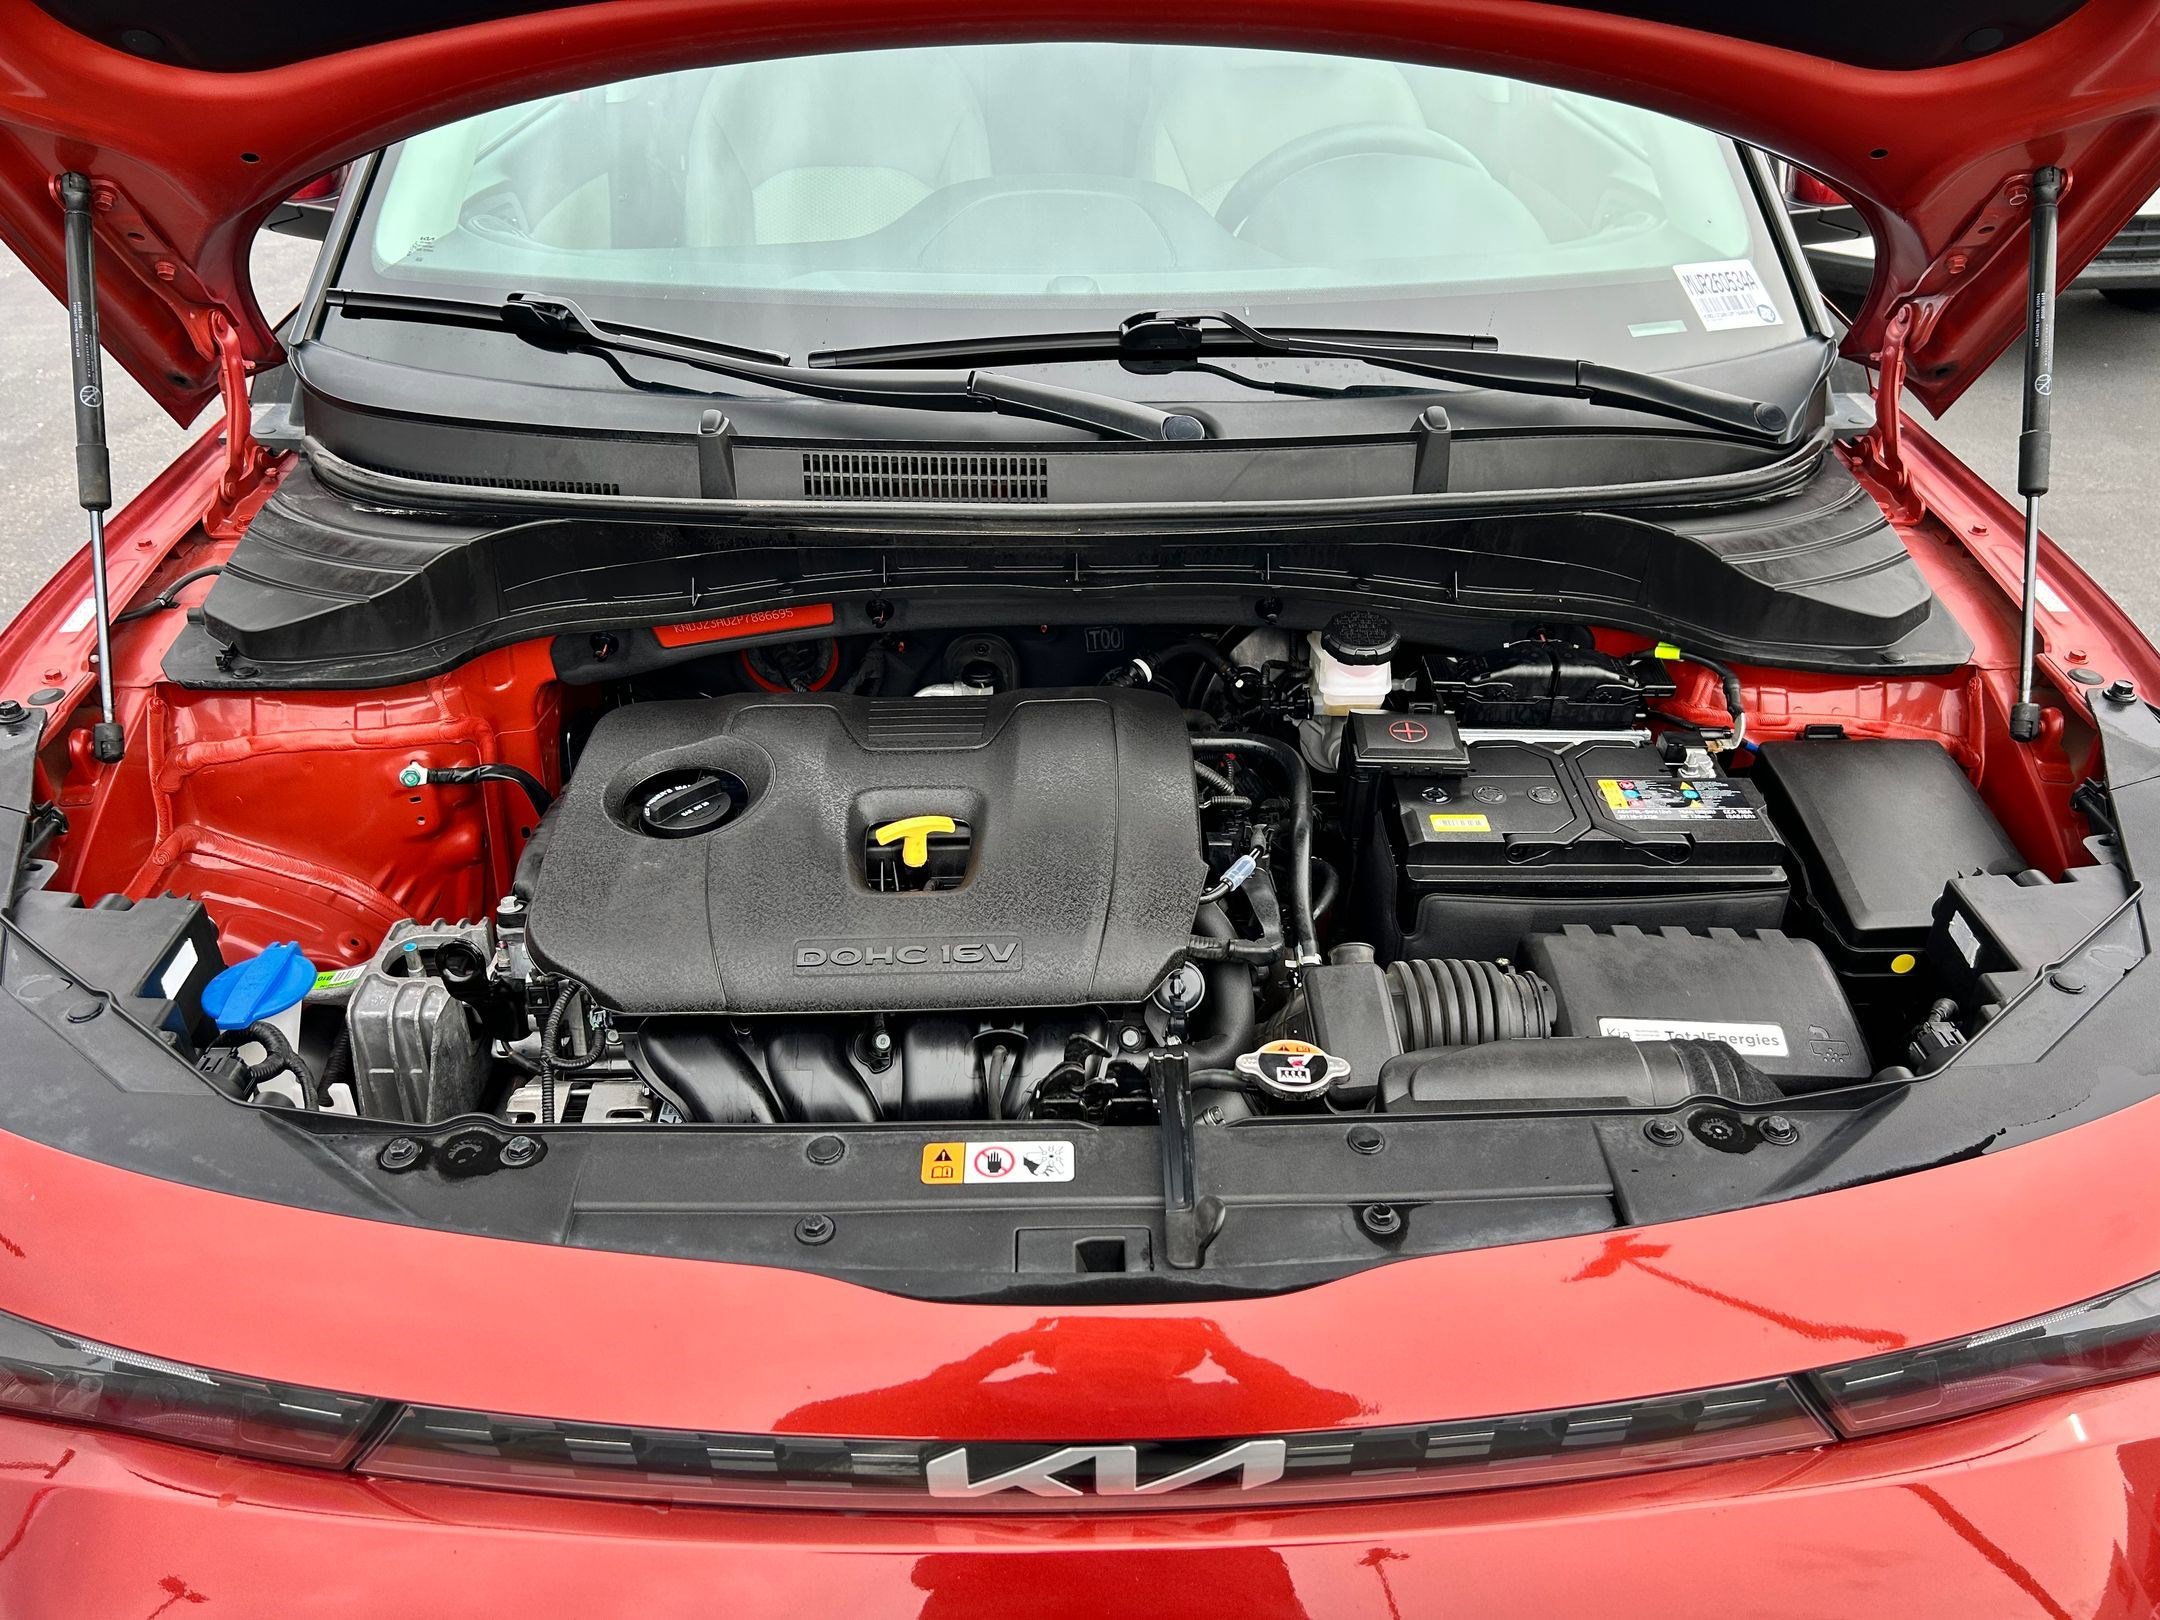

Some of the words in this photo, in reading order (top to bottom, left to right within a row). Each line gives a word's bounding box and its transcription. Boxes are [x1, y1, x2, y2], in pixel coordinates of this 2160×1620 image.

[1682, 270, 1759, 295] MUR260534A
[796, 945, 928, 968] DOHC
[941, 943, 1018, 964] 16V
[925, 1438, 1287, 1498] KIA
